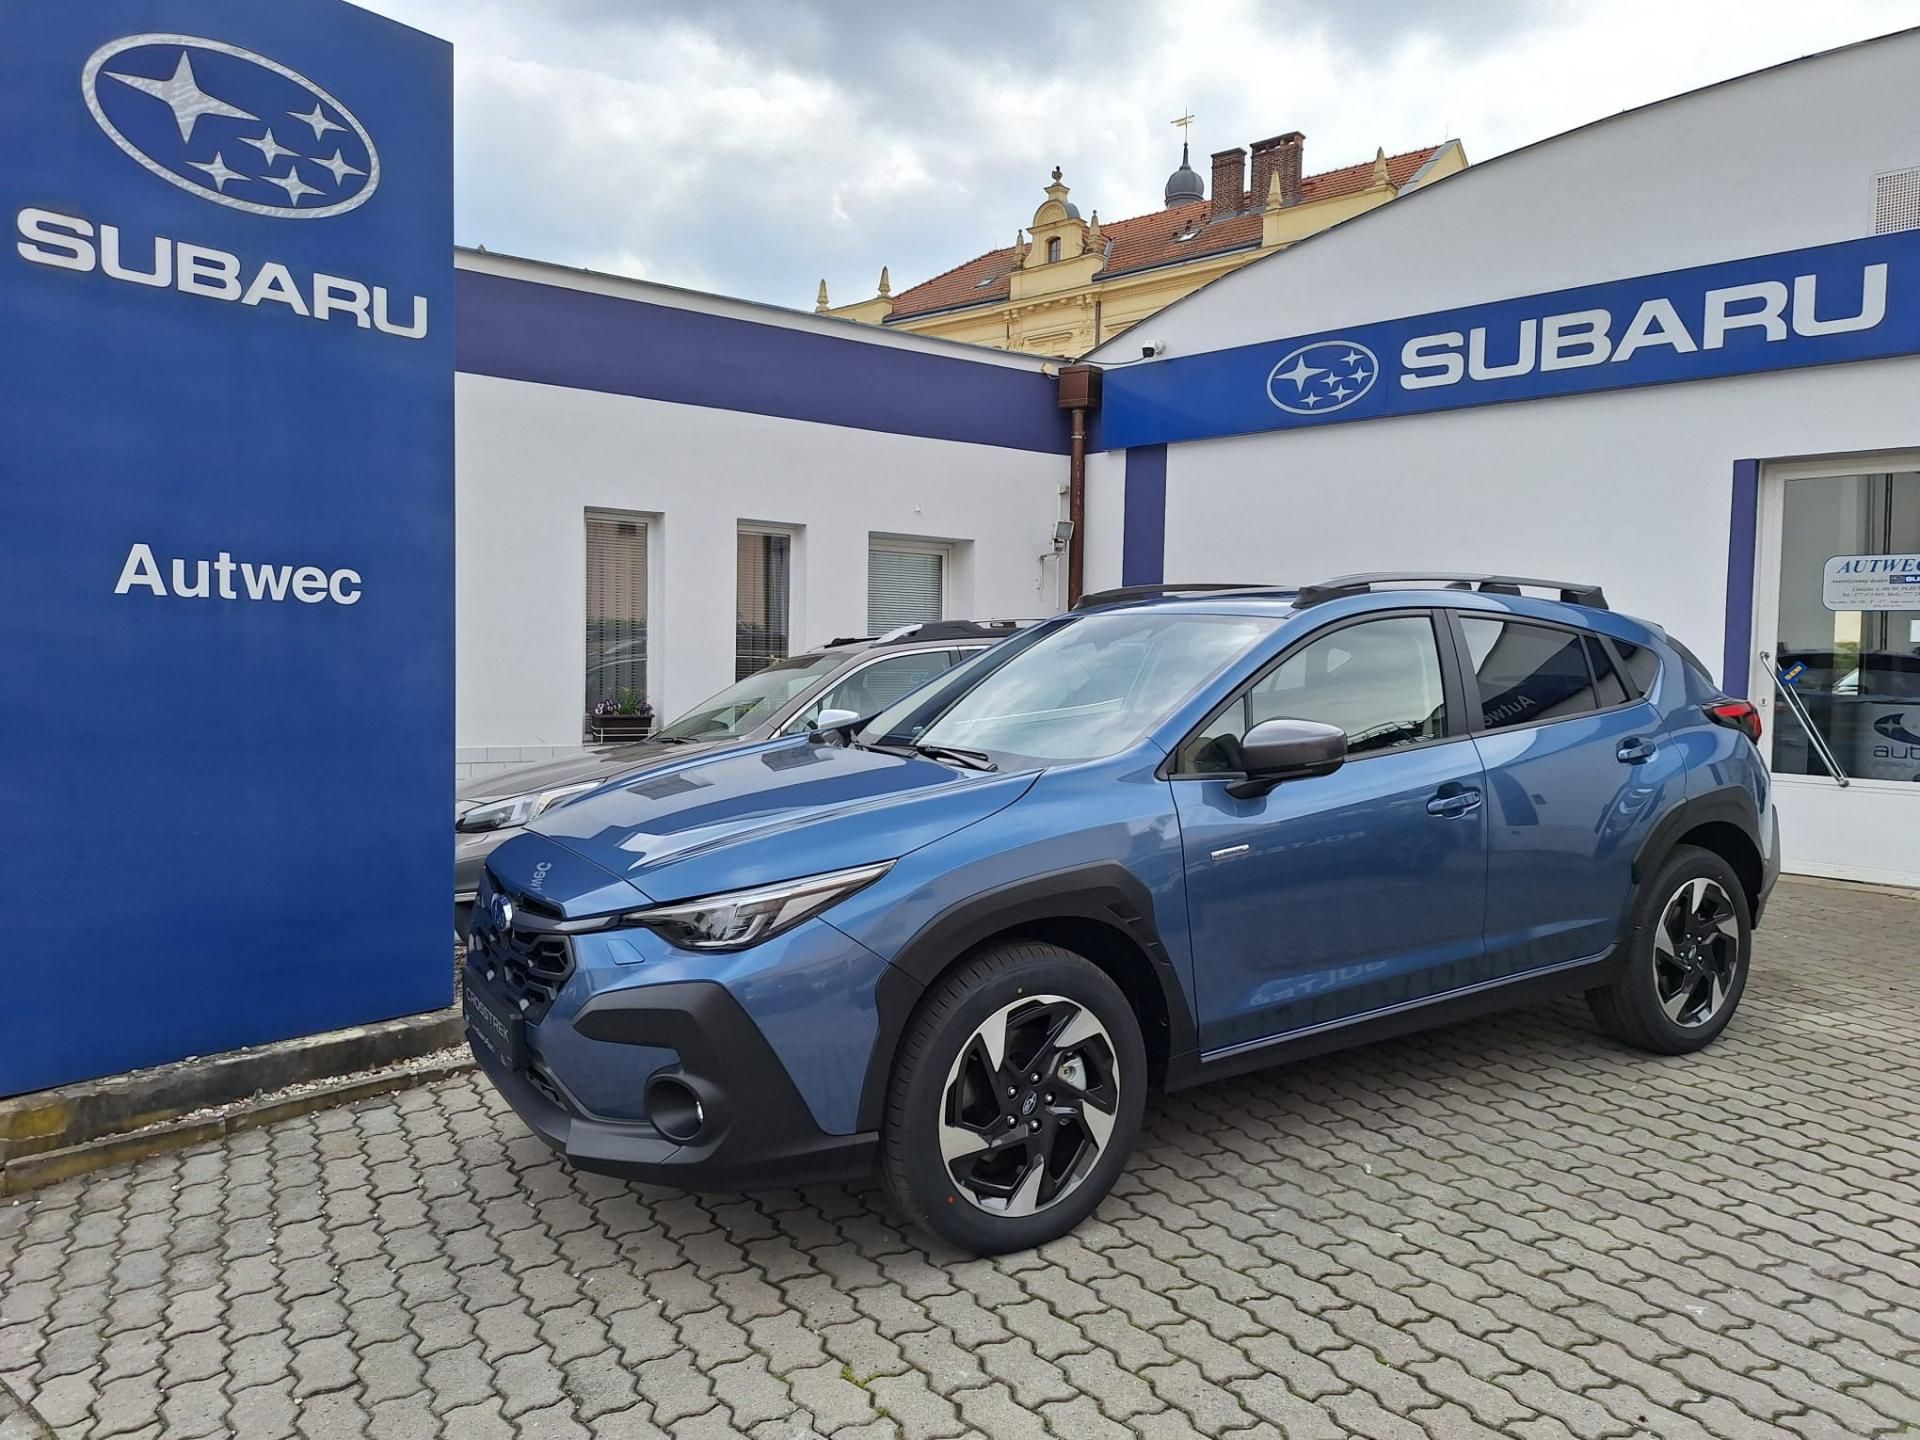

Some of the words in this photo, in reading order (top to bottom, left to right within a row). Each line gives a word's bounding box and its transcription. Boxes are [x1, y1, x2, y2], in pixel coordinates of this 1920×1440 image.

[17, 207, 428, 339] SUBARU
[1399, 263, 1888, 391] SUBARU
[114, 543, 363, 606] Autwec
